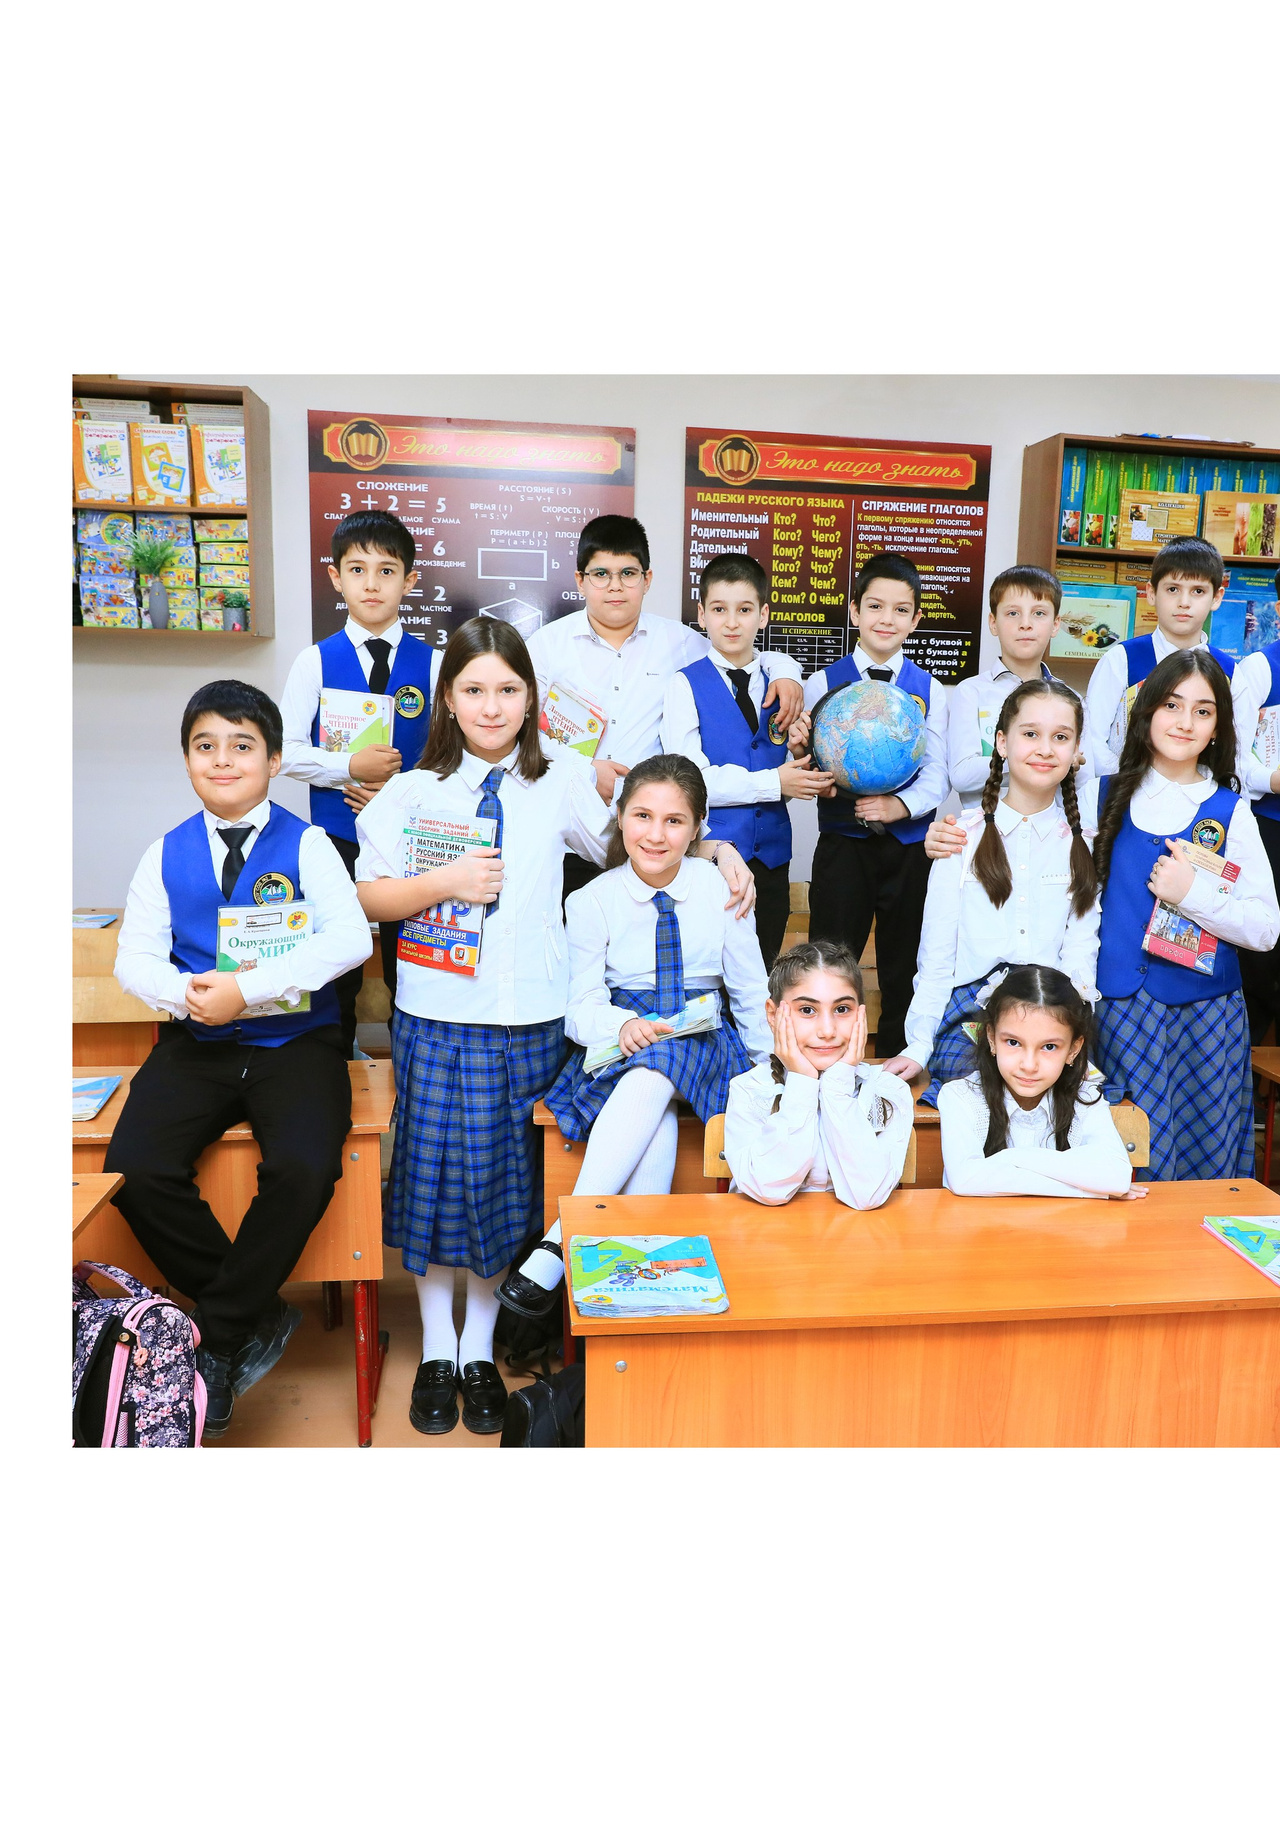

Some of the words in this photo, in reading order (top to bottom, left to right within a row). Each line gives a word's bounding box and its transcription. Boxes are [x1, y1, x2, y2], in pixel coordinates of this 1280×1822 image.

[766, 451, 819, 470] Это
[824, 460, 884, 478] надо
[883, 463, 964, 481] знать
[356, 481, 429, 492] СЛОЖЕНИЕ
[499, 485, 554, 495] РАССТОЯНИЕ
[340, 493, 352, 510] 3
[387, 495, 399, 511] 2
[436, 497, 447, 513] 5
[697, 492, 745, 504] ПАДЕЖИ
[748, 495, 804, 506] РУССКОГО
[807, 498, 845, 508] ЯЗЫКА
[542, 506, 581, 514] СКОРОСТЬ
[862, 500, 928, 514] СПРЯЖЕНИЕ
[930, 504, 984, 516] ГЛАГОЛОВ
[691, 508, 769, 524] Именительный
[774, 512, 797, 525] Кто?
[812, 514, 836, 527] Что?
[864, 515, 893, 524] первому
[895, 516, 934, 525] спряжению
[691, 524, 760, 540] Родительный
[773, 528, 802, 541] Кого?
[812, 530, 841, 543] Чего?
[858, 533, 882, 542] форме
[890, 526, 918, 534] которые
[926, 528, 983, 538] неопределенной
[433, 541, 446, 556] 6
[690, 540, 748, 555] Дательный
[772, 544, 804, 560] Кому?
[812, 546, 843, 562] Чему?
[885, 544, 927, 553] исключение
[413, 560, 466, 568] ПРОИЗВЕДЕНИЕ
[552, 560, 560, 570] b
[772, 560, 800, 572] Кого?
[811, 562, 834, 574] Что?
[936, 566, 971, 574] относятся
[509, 582, 516, 590] a
[772, 576, 798, 588] Кем?
[810, 576, 836, 590] Чем?
[434, 586, 447, 602] 2
[771, 591, 778, 604] О
[781, 592, 806, 604] ком?
[810, 592, 817, 604] О
[820, 593, 844, 606] чём?
[770, 612, 826, 622] ГЛАГОЛОВ
[436, 630, 448, 645] 3
[788, 628, 832, 636] СПРЯЖЕНИЕ
[930, 638, 962, 646] буквой
[926, 648, 959, 656] буквой
[925, 658, 958, 666] буквой
[322, 710, 366, 722] Литературное
[548, 703, 586, 735] Литературное
[328, 720, 358, 730] ЧТЕНИЕ
[552, 711, 578, 738] ЧТЕНИЕ
[419, 818, 470, 830] УНИВЕРСАЛЬНЫЙ
[443, 829, 469, 838] ЗАДАНИЙ
[416, 838, 466, 852] МАТЕМАТИКА
[416, 848, 446, 860] РУССКИЙ
[404, 920, 430, 933] ТИПОВЫЕ
[432, 927, 467, 940] ЗАДАНИЯ
[228, 932, 306, 949] Окружающий
[402, 930, 412, 938] ВСЕ
[412, 932, 447, 946] ПРЕДМЕТЫ
[258, 943, 296, 959] МИР
[592, 1285, 709, 1294] Математика
